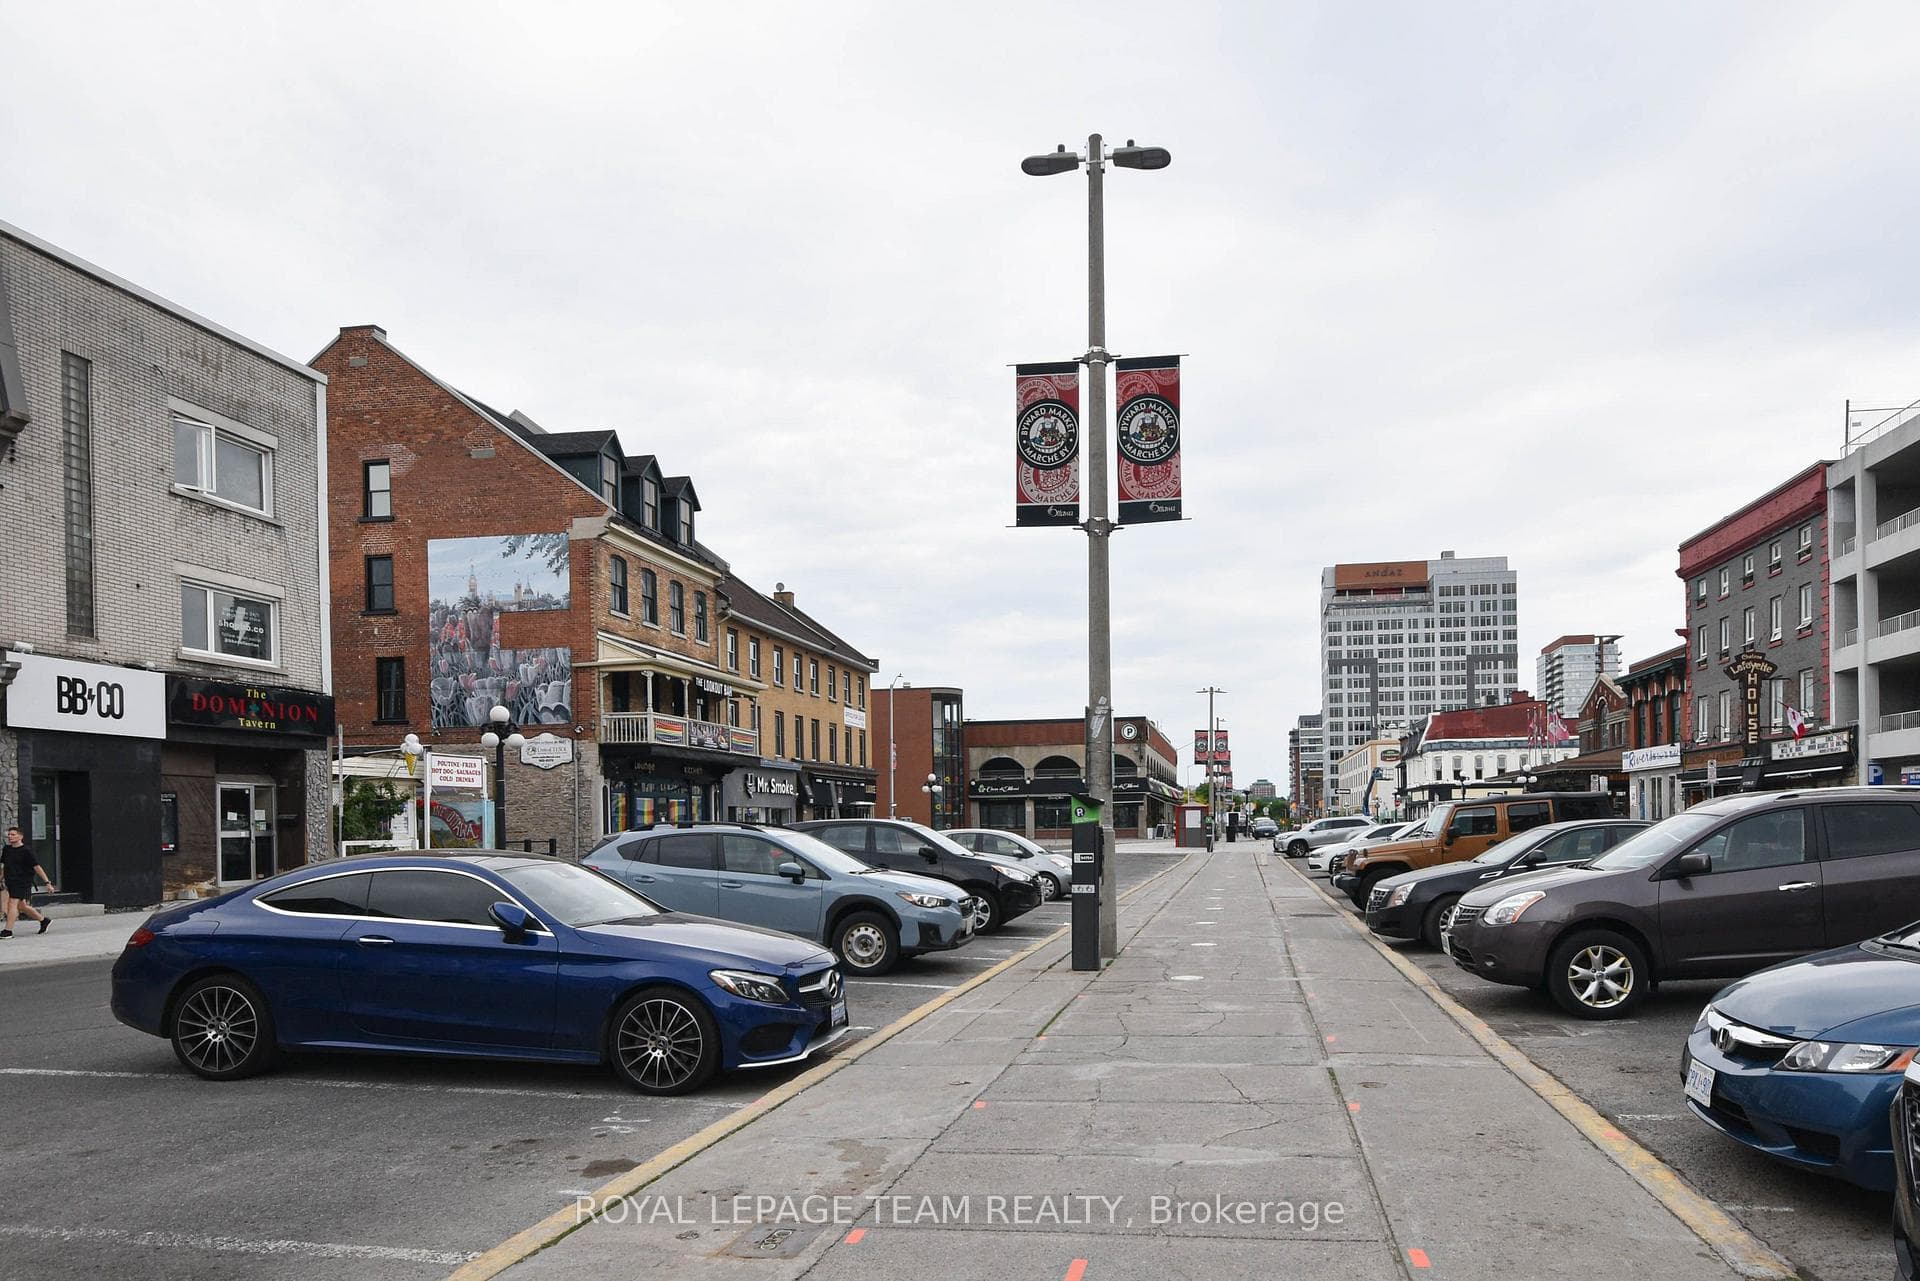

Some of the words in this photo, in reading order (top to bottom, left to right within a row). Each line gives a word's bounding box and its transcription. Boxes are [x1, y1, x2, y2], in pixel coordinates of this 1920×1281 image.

[1020, 407, 1046, 437] BYWARD
[1048, 407, 1076, 434] MARKET
[1120, 402, 1146, 431] BYWARD
[1148, 402, 1176, 430] MARKET
[1060, 446, 1070, 457] BY
[1160, 441, 1171, 453] BY
[1730, 660, 1773, 674] Lafayette
[246, 688, 267, 700] The
[1747, 673, 1758, 744] HOUSE
[238, 717, 277, 730] Tavern
[1868, 765, 1883, 783] P
[757, 776, 769, 793] Mr.
[770, 778, 794, 795] Smoke
